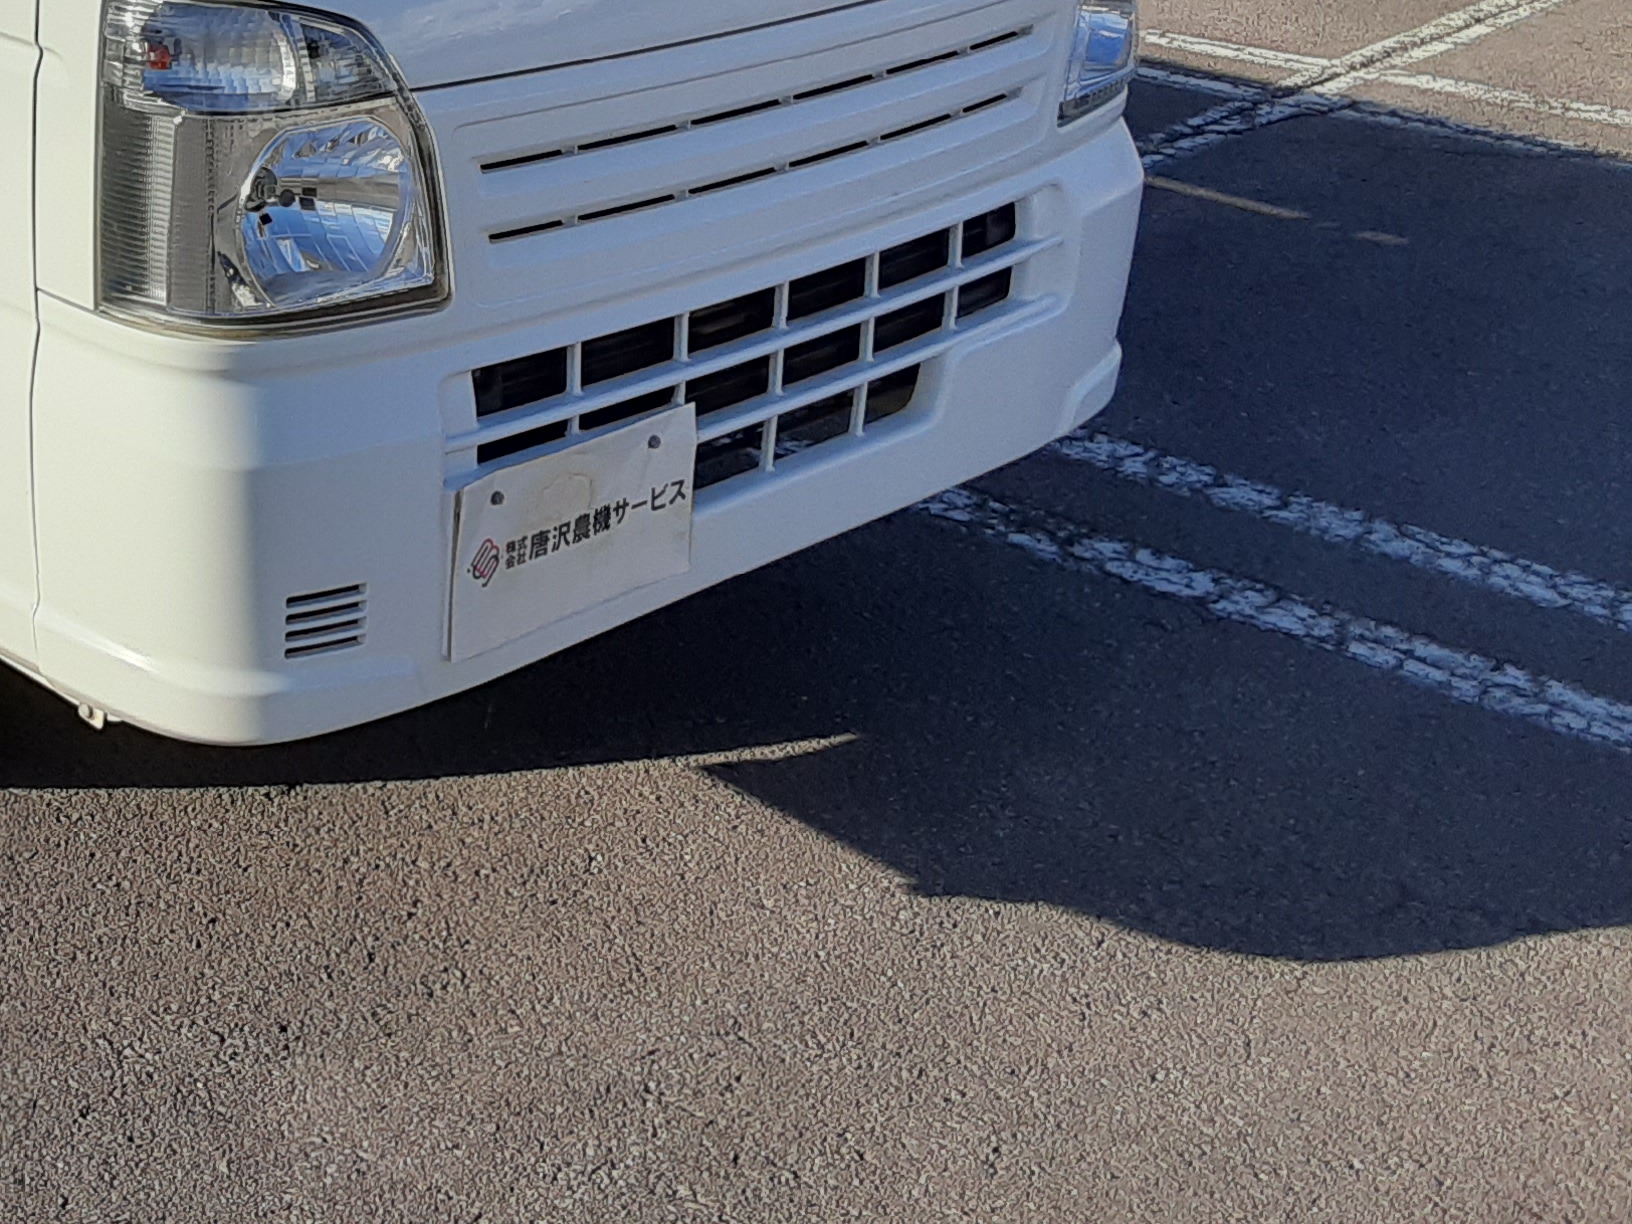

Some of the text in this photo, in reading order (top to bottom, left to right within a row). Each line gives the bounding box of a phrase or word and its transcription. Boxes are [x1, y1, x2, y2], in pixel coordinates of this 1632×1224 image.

[529, 479, 687, 560] 唐沢農機サービス
